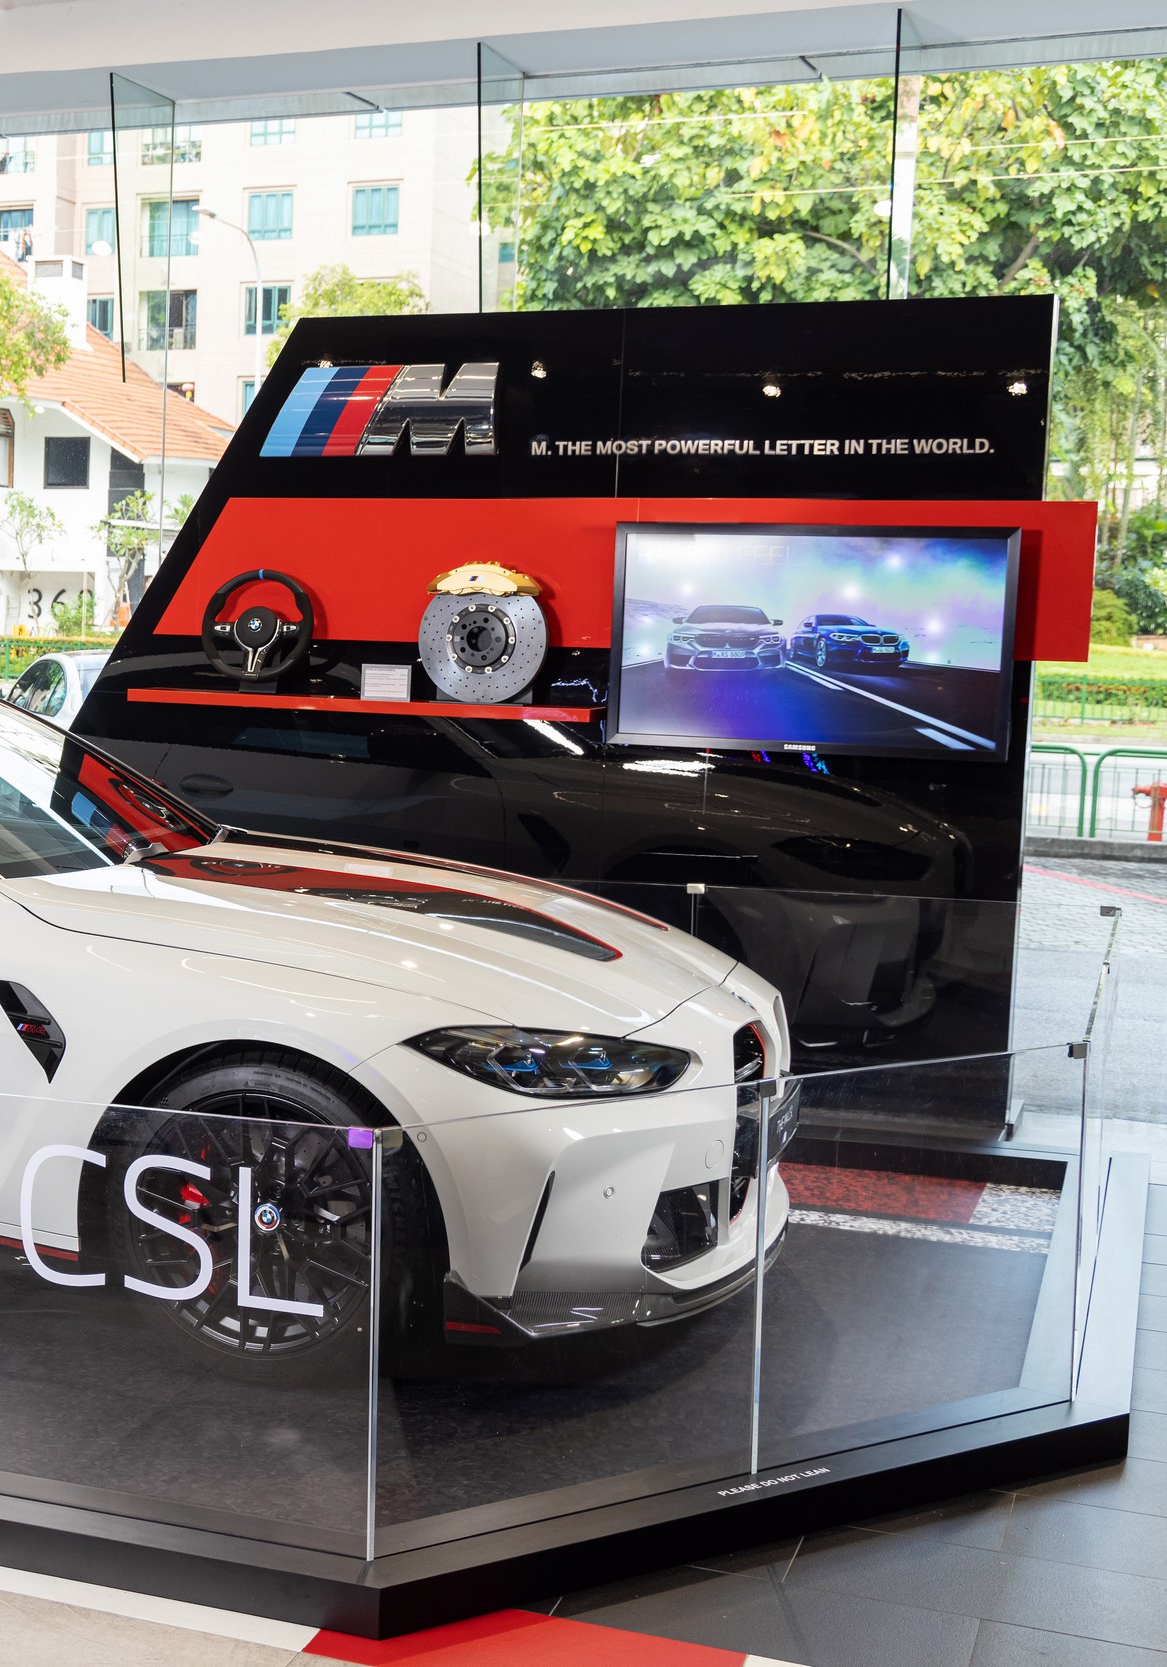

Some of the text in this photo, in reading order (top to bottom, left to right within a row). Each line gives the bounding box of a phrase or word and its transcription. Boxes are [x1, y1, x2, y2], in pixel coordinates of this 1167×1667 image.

[531, 437, 995, 456] M. THE MOST POWERFUL LETTER IN THE WORLD.
[783, 743, 816, 751] SAMSUNG
[20, 1144, 324, 1317] CSL
[717, 1467, 831, 1497] PLEASE DO NOT LEAN
